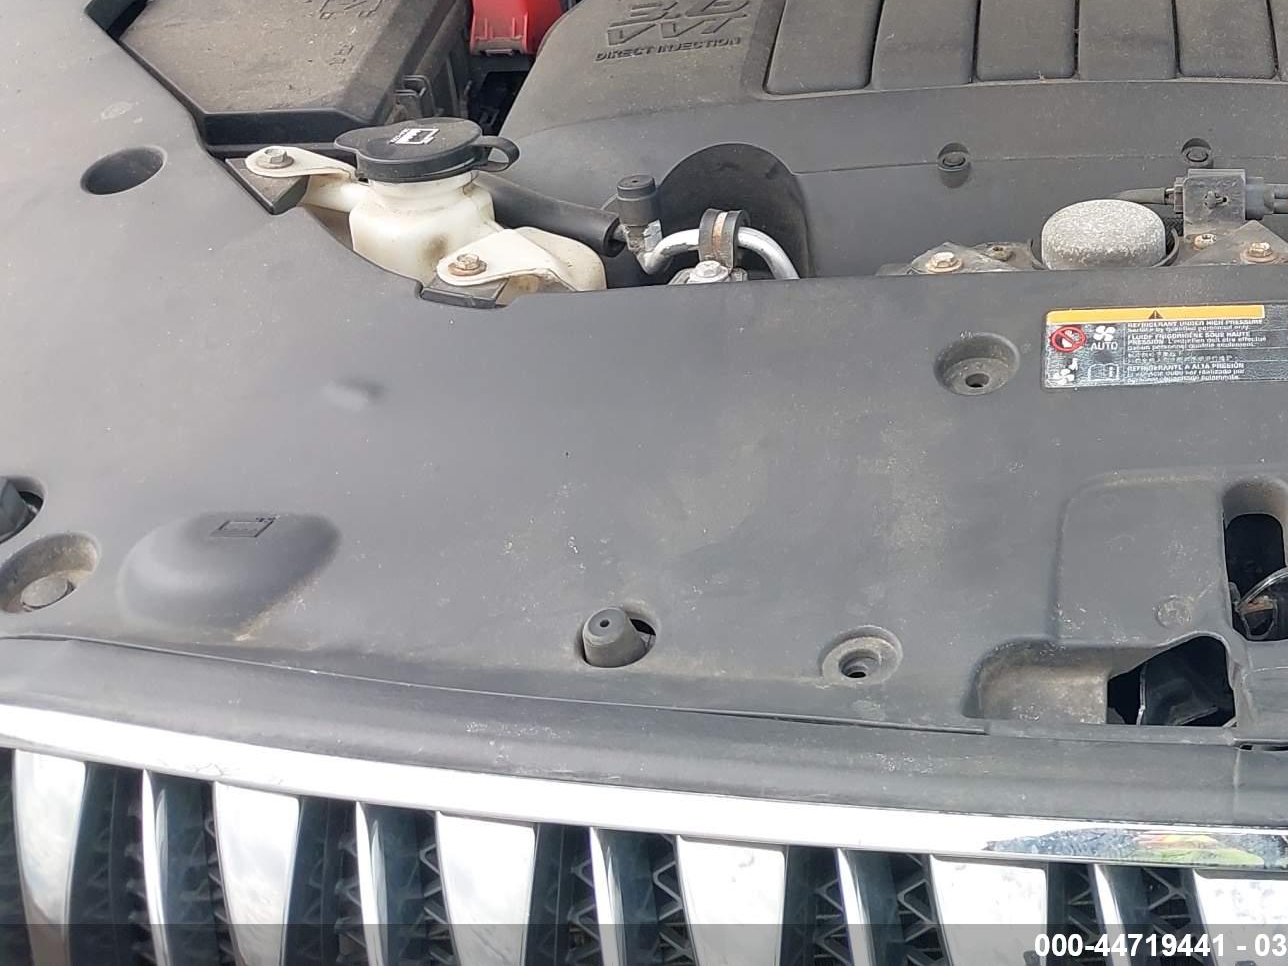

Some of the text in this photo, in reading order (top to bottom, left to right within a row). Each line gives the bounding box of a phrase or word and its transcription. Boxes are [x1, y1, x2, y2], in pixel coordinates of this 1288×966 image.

[607, 15, 748, 46] VVT
[595, 36, 742, 62] DIRECT INJECTION
[1090, 341, 1118, 351] AUTO
